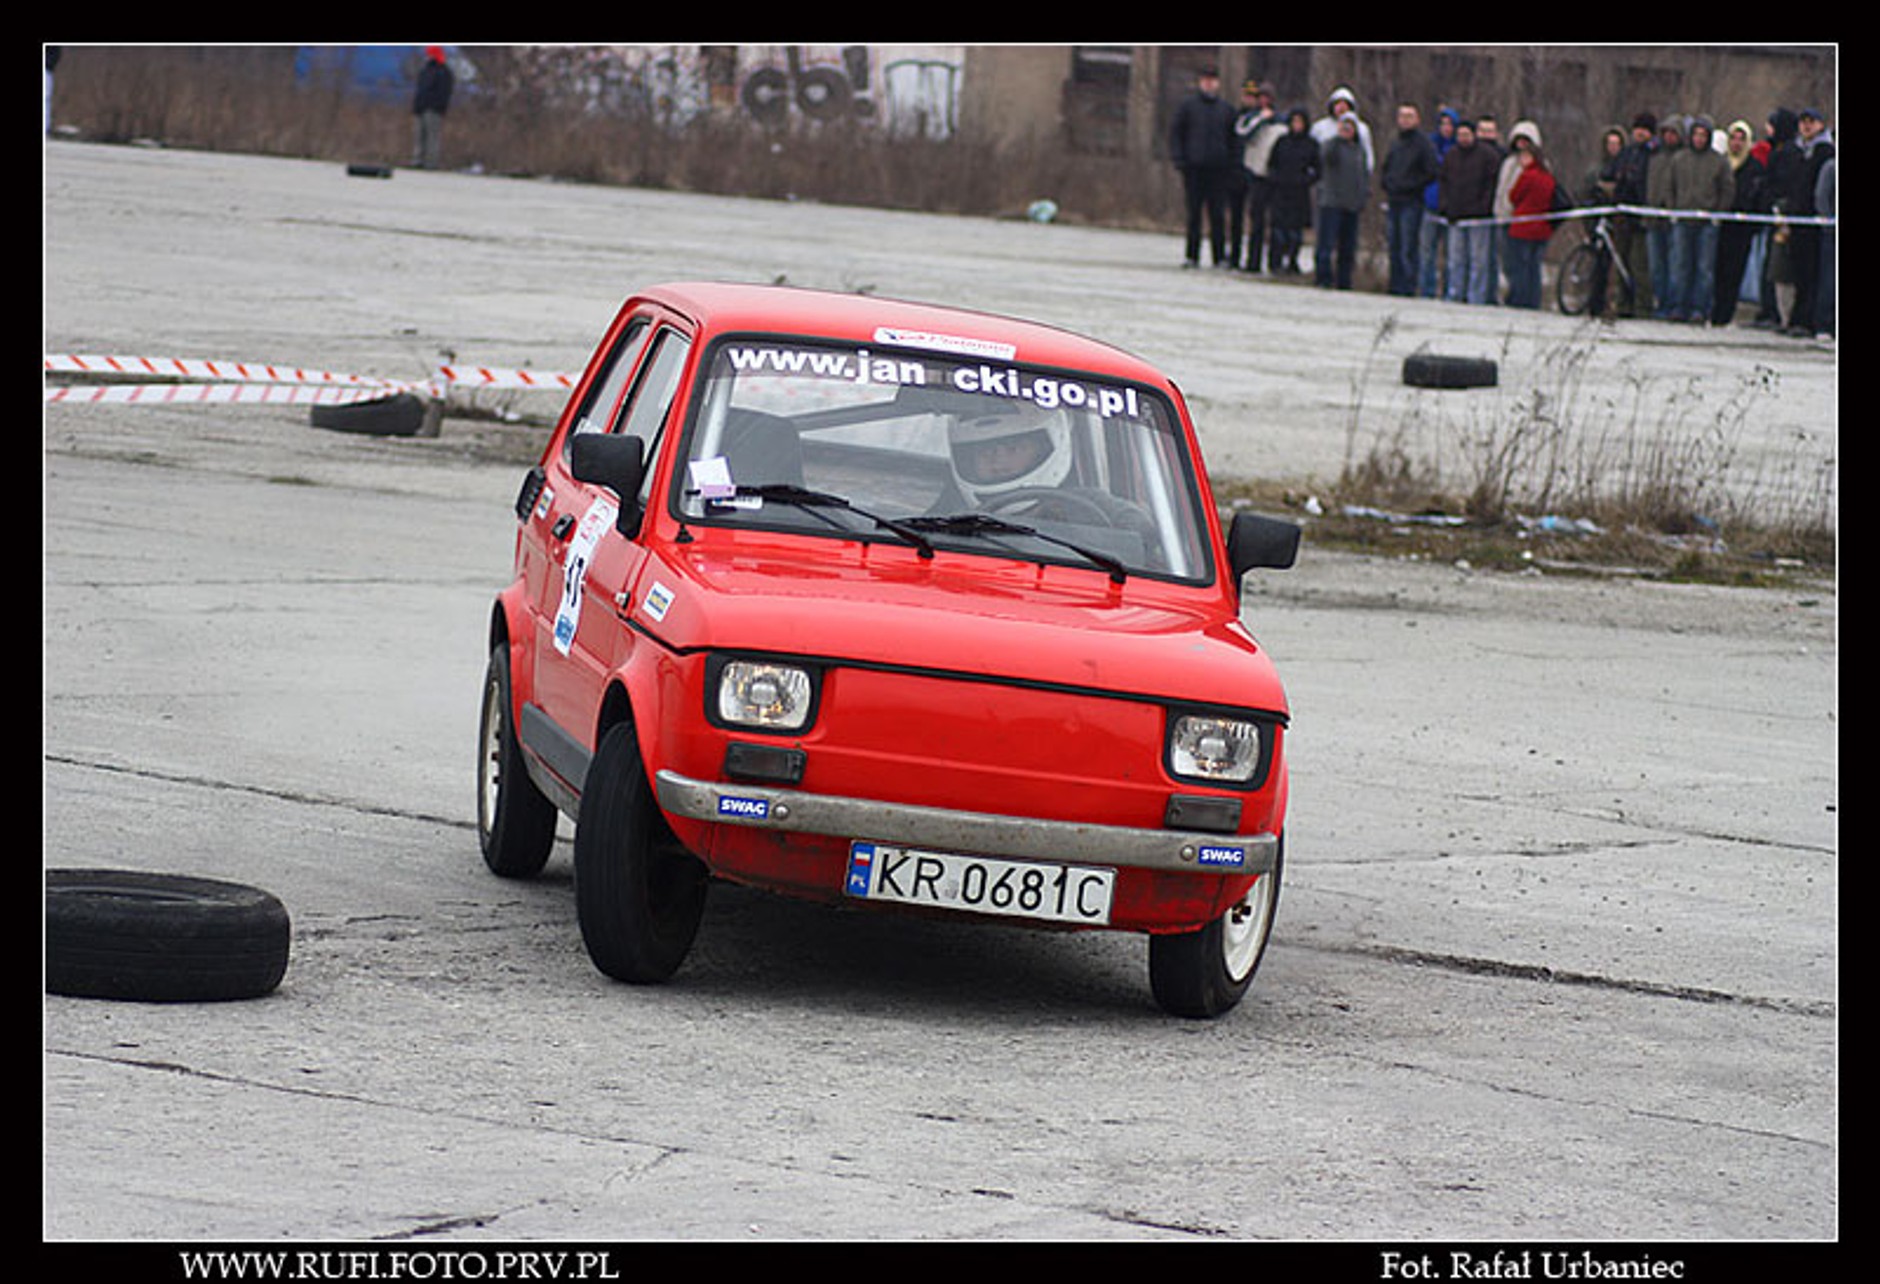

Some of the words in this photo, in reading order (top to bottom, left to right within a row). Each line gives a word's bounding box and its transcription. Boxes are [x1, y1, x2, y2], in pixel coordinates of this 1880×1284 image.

[721, 799, 766, 815] SWAG
[1201, 847, 1243, 863] SWAG
[850, 874, 866, 888] PL
[877, 854, 945, 901] KR
[961, 864, 1104, 918] 0681C
